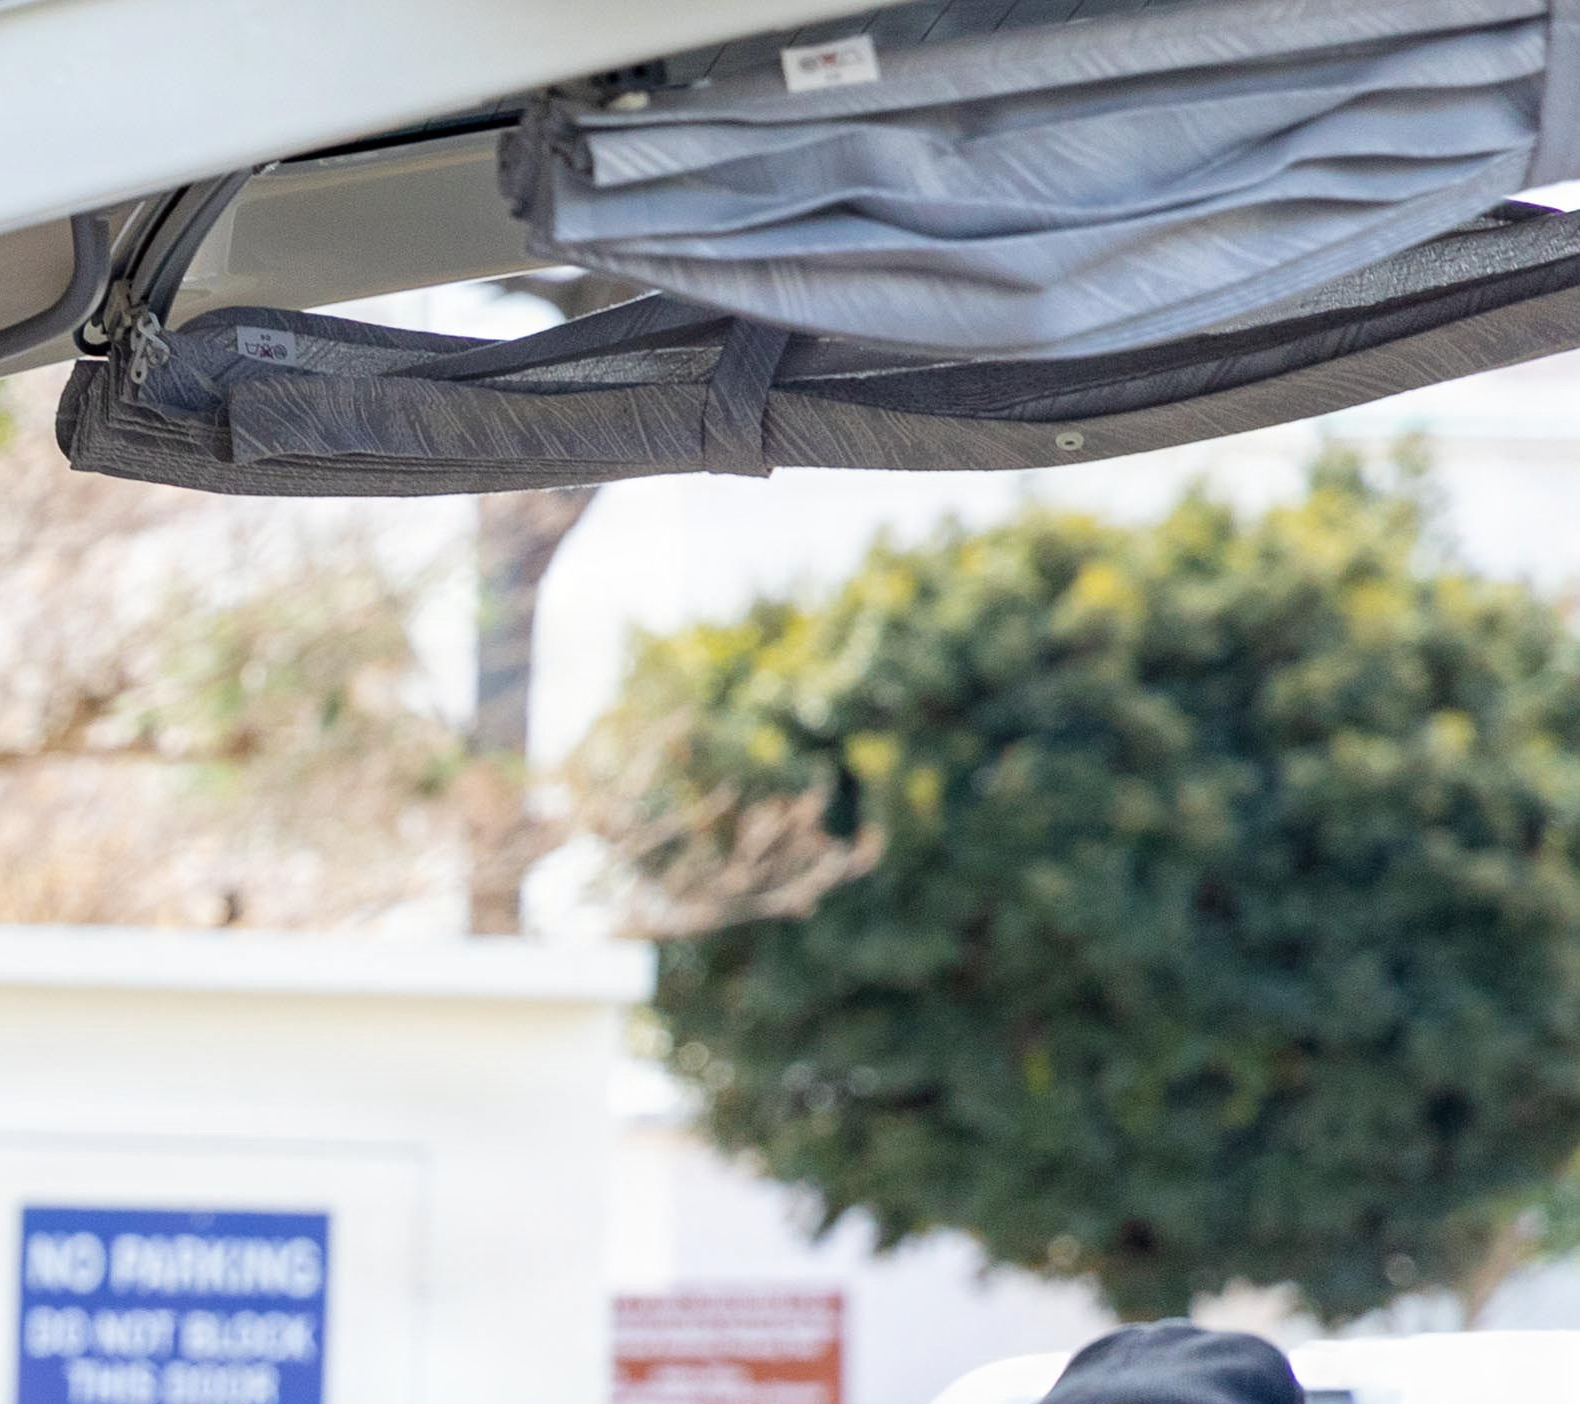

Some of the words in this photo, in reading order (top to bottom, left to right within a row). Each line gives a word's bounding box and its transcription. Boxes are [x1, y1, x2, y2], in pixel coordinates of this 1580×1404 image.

[25, 1231, 106, 1295] NO
[110, 1232, 323, 1299] PARKING
[25, 1305, 90, 1358] DO
[93, 1307, 177, 1360] NOT
[180, 1309, 316, 1365] BLOCK
